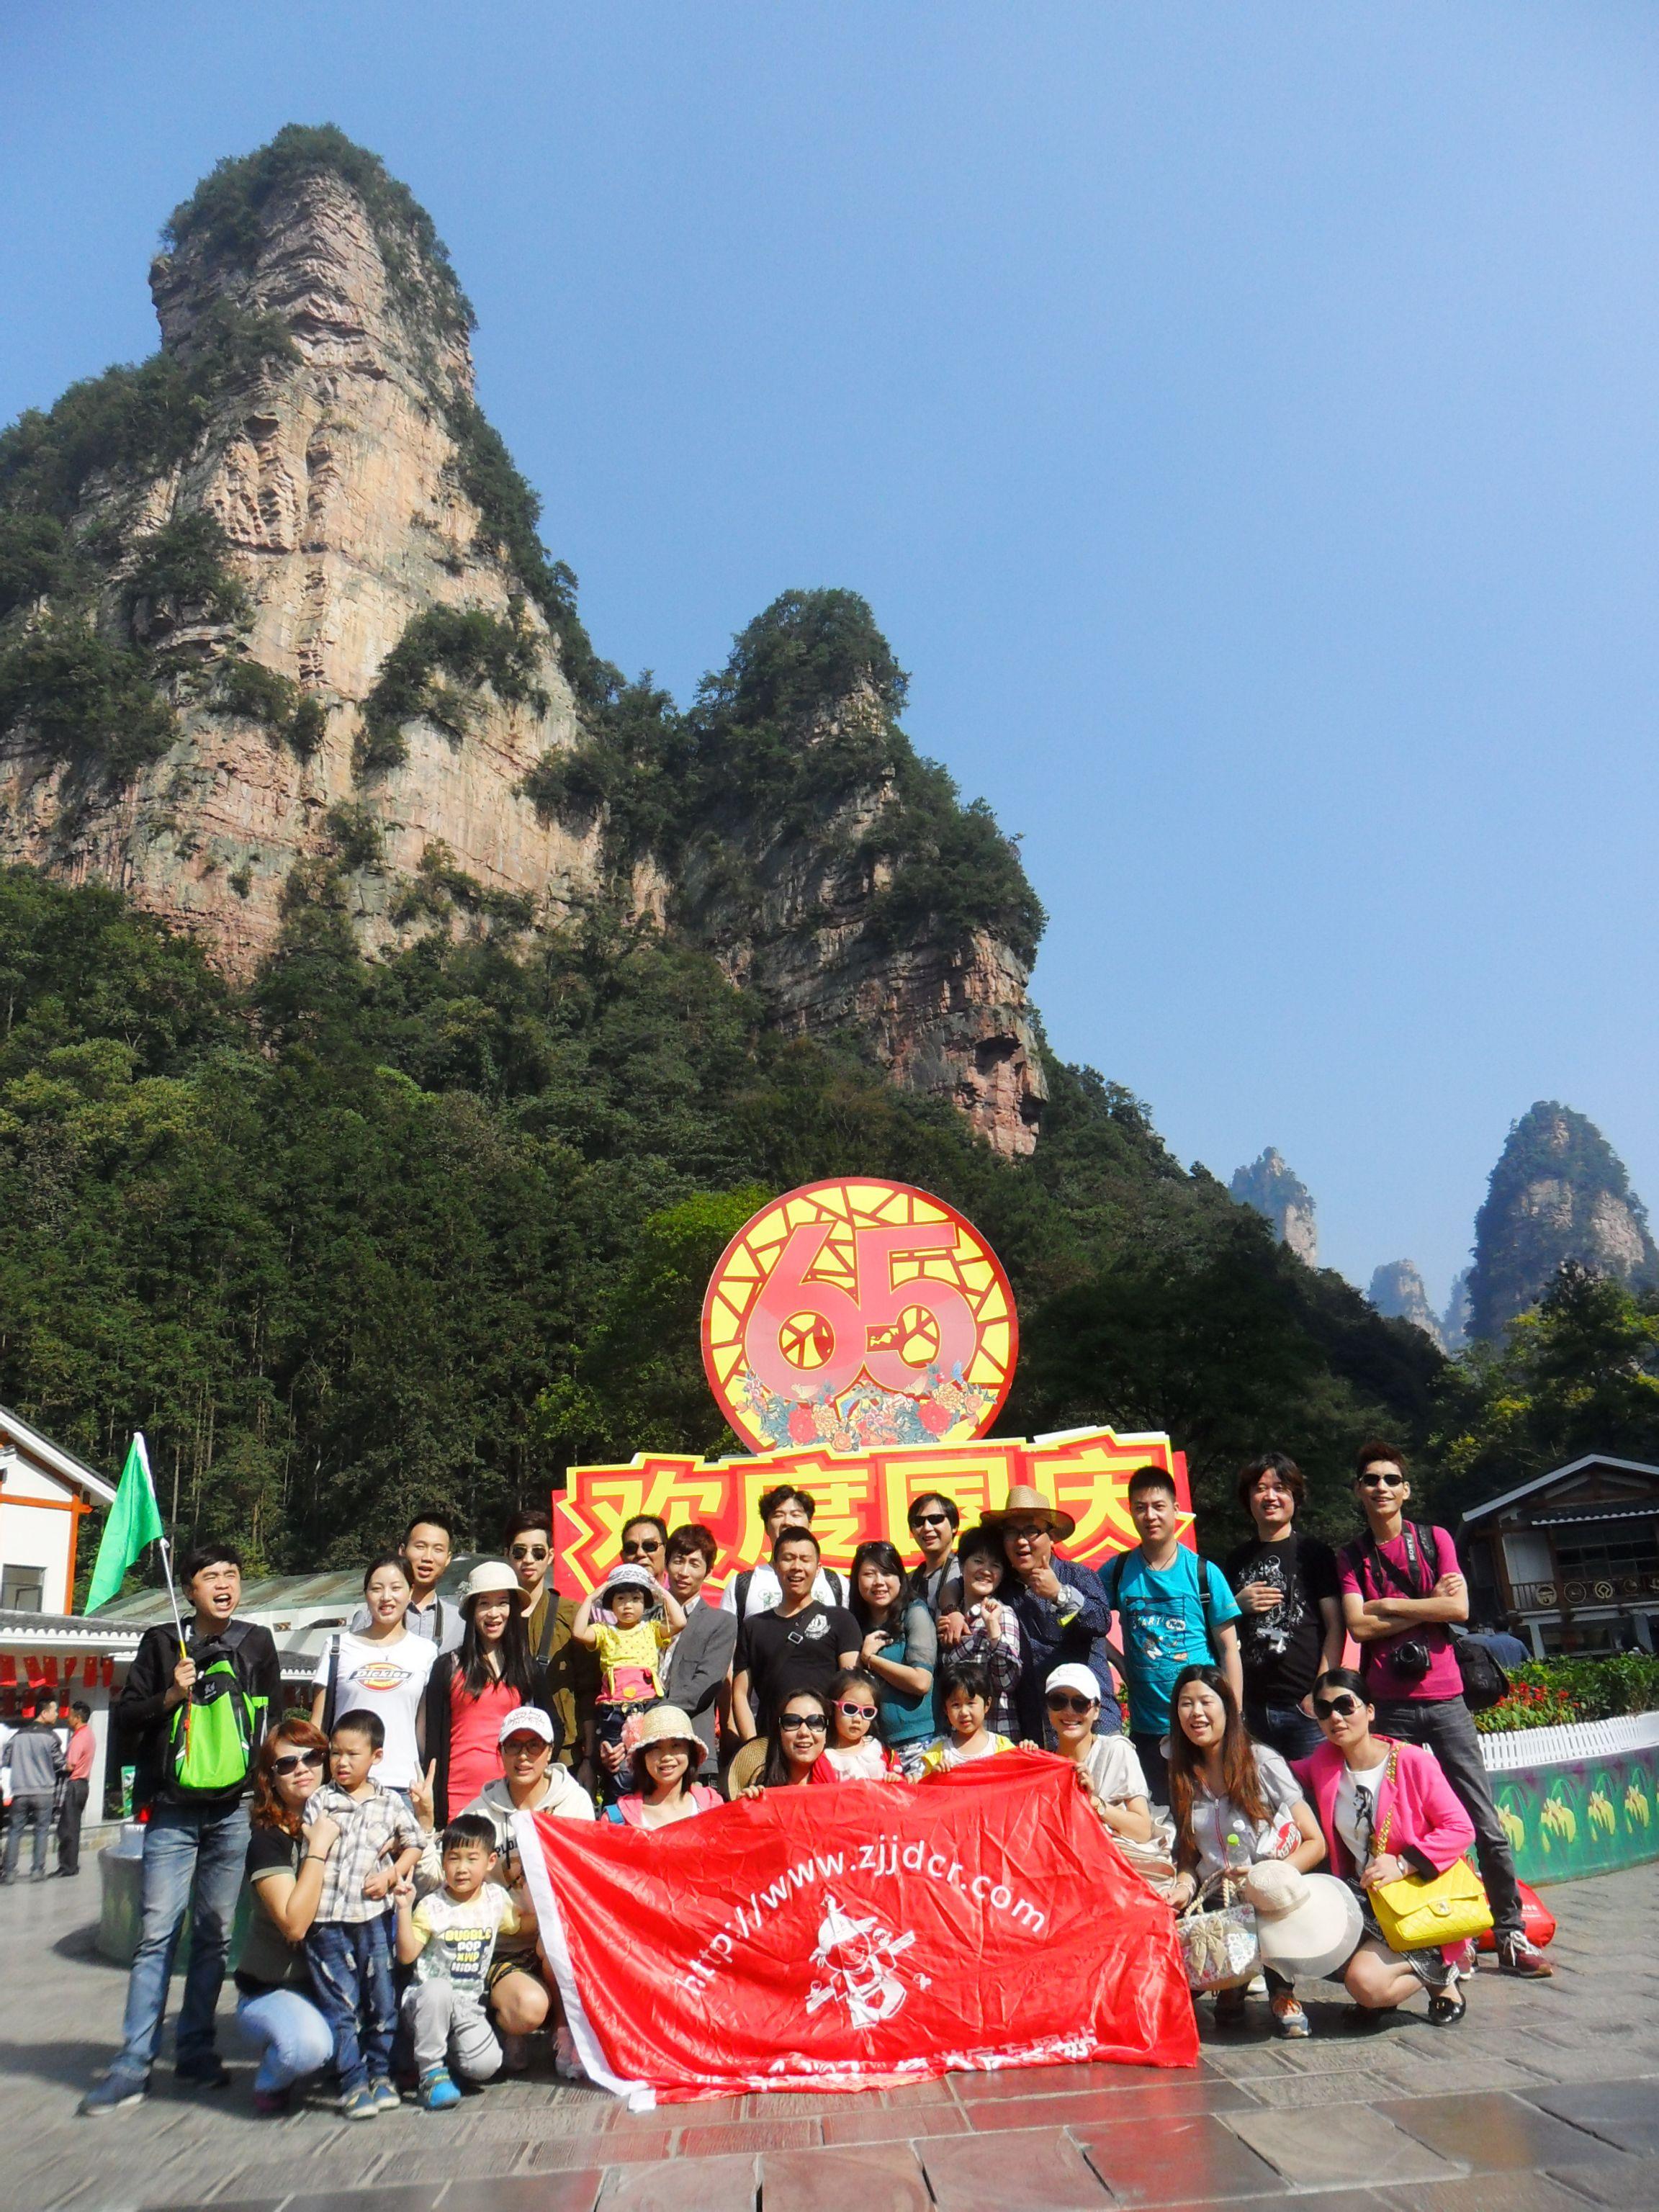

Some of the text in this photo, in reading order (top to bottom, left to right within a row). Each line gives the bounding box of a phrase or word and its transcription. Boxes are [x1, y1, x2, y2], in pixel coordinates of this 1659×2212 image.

[745, 1222, 977, 1402] 65
[591, 1447, 1153, 1569] 欢度国庆
[457, 1941, 482, 1952] POP
